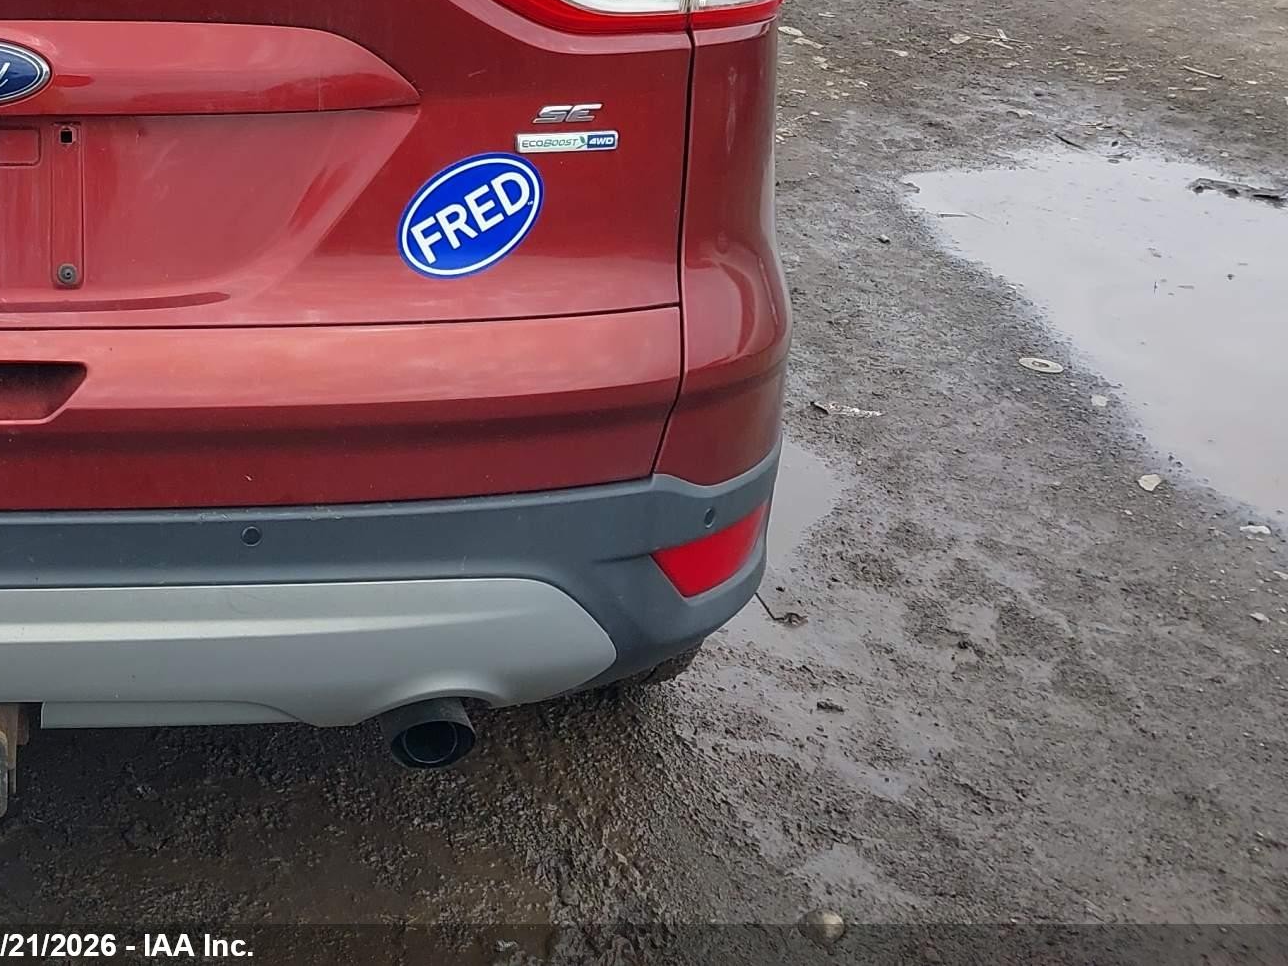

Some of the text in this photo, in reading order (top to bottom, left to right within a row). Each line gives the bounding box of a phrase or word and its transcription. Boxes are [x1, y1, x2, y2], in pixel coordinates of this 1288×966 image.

[532, 102, 603, 124] SE
[588, 136, 615, 146] 4WD
[410, 171, 531, 265] FRED
